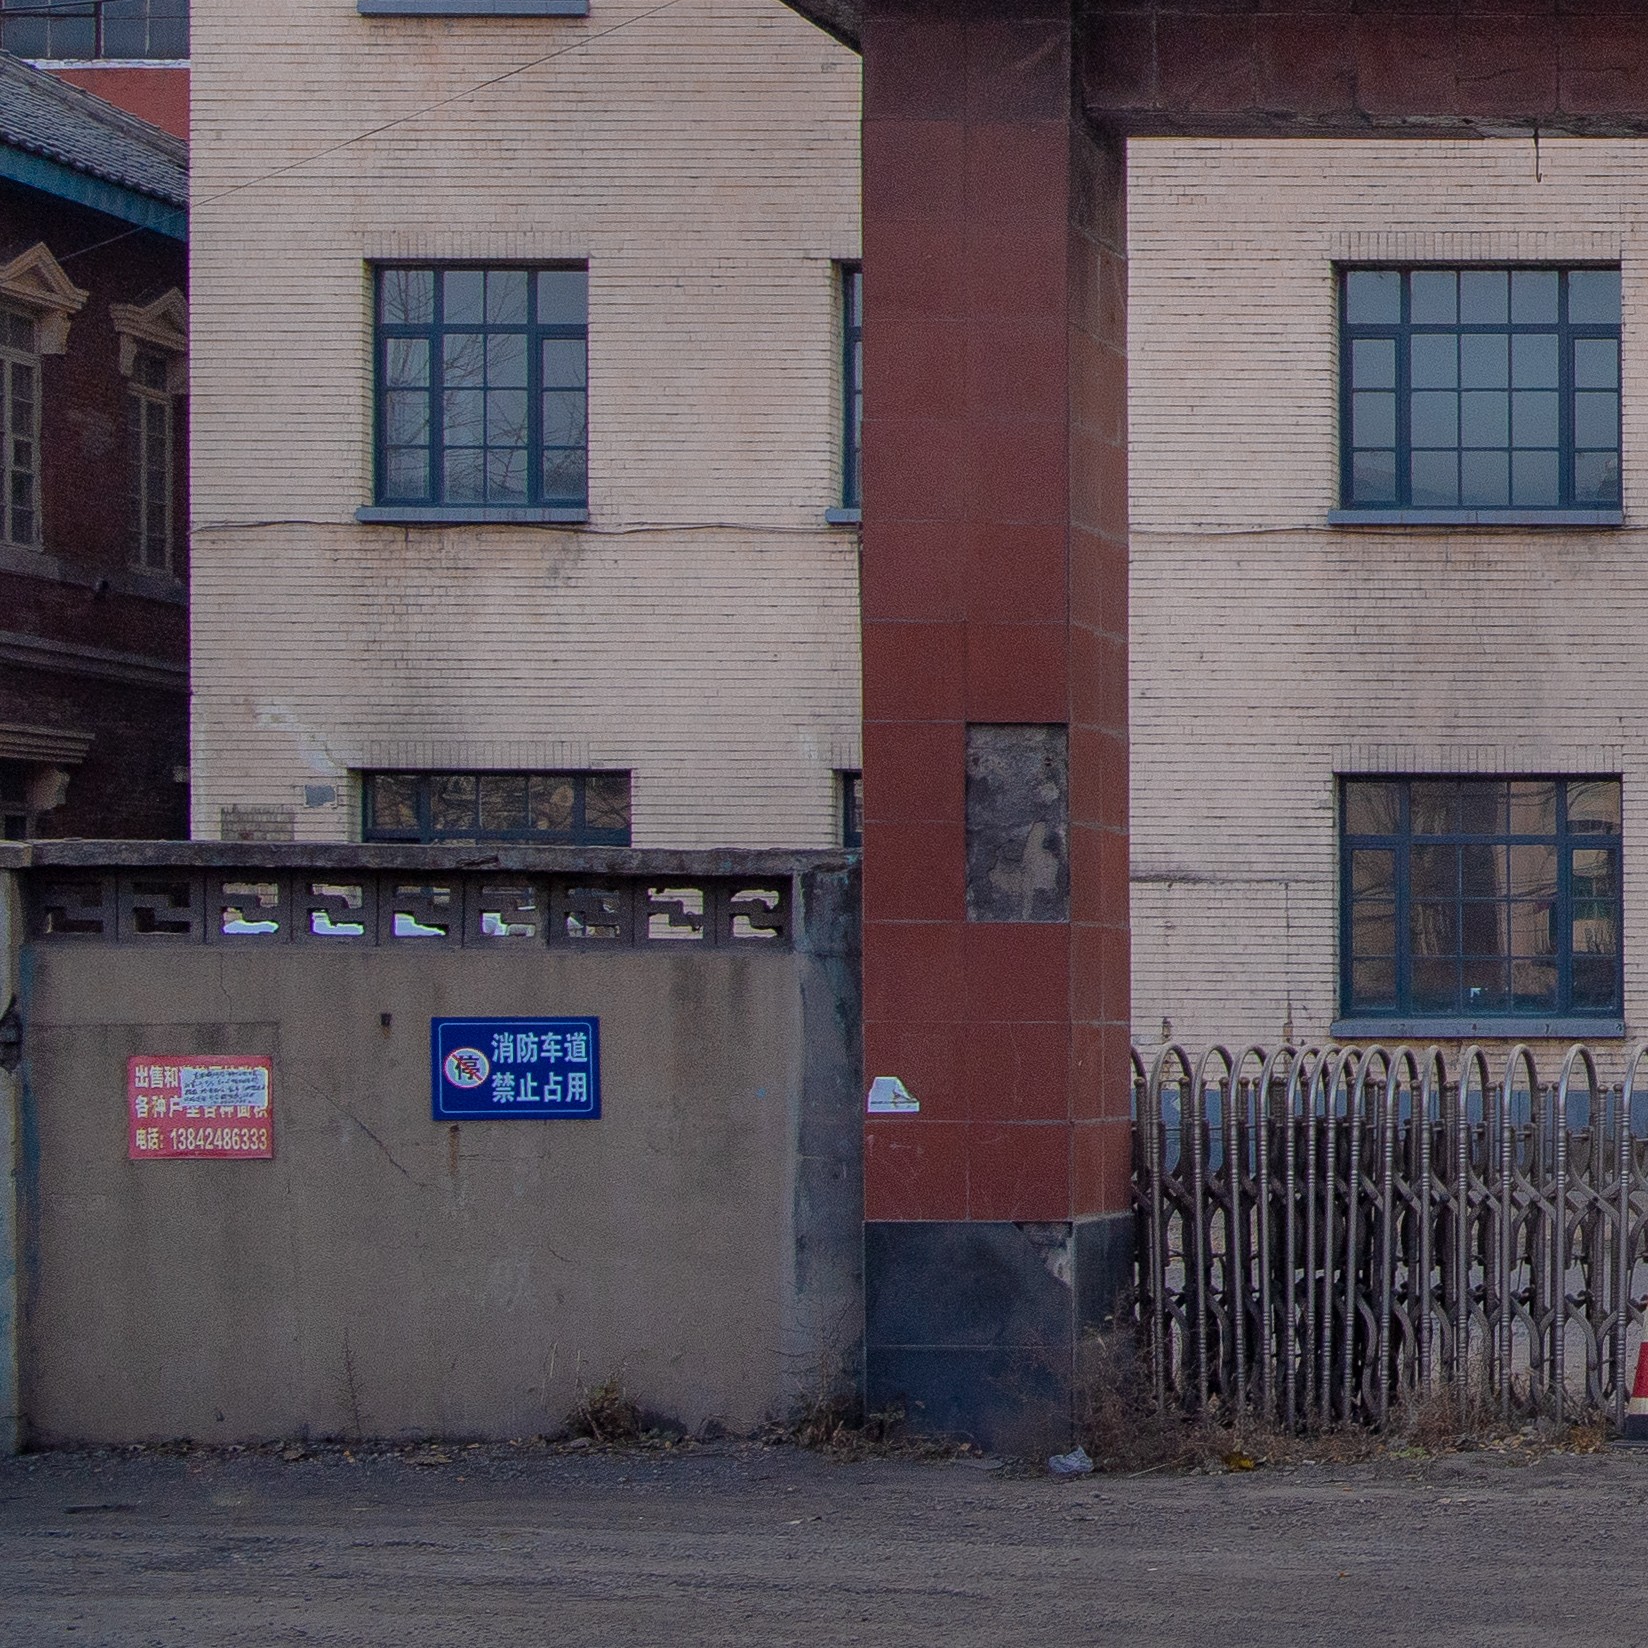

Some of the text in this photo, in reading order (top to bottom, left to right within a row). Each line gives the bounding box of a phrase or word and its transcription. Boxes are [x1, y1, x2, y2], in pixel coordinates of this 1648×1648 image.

[490, 1032, 588, 1064] 消防车道
[491, 1072, 588, 1104] 禁止占用
